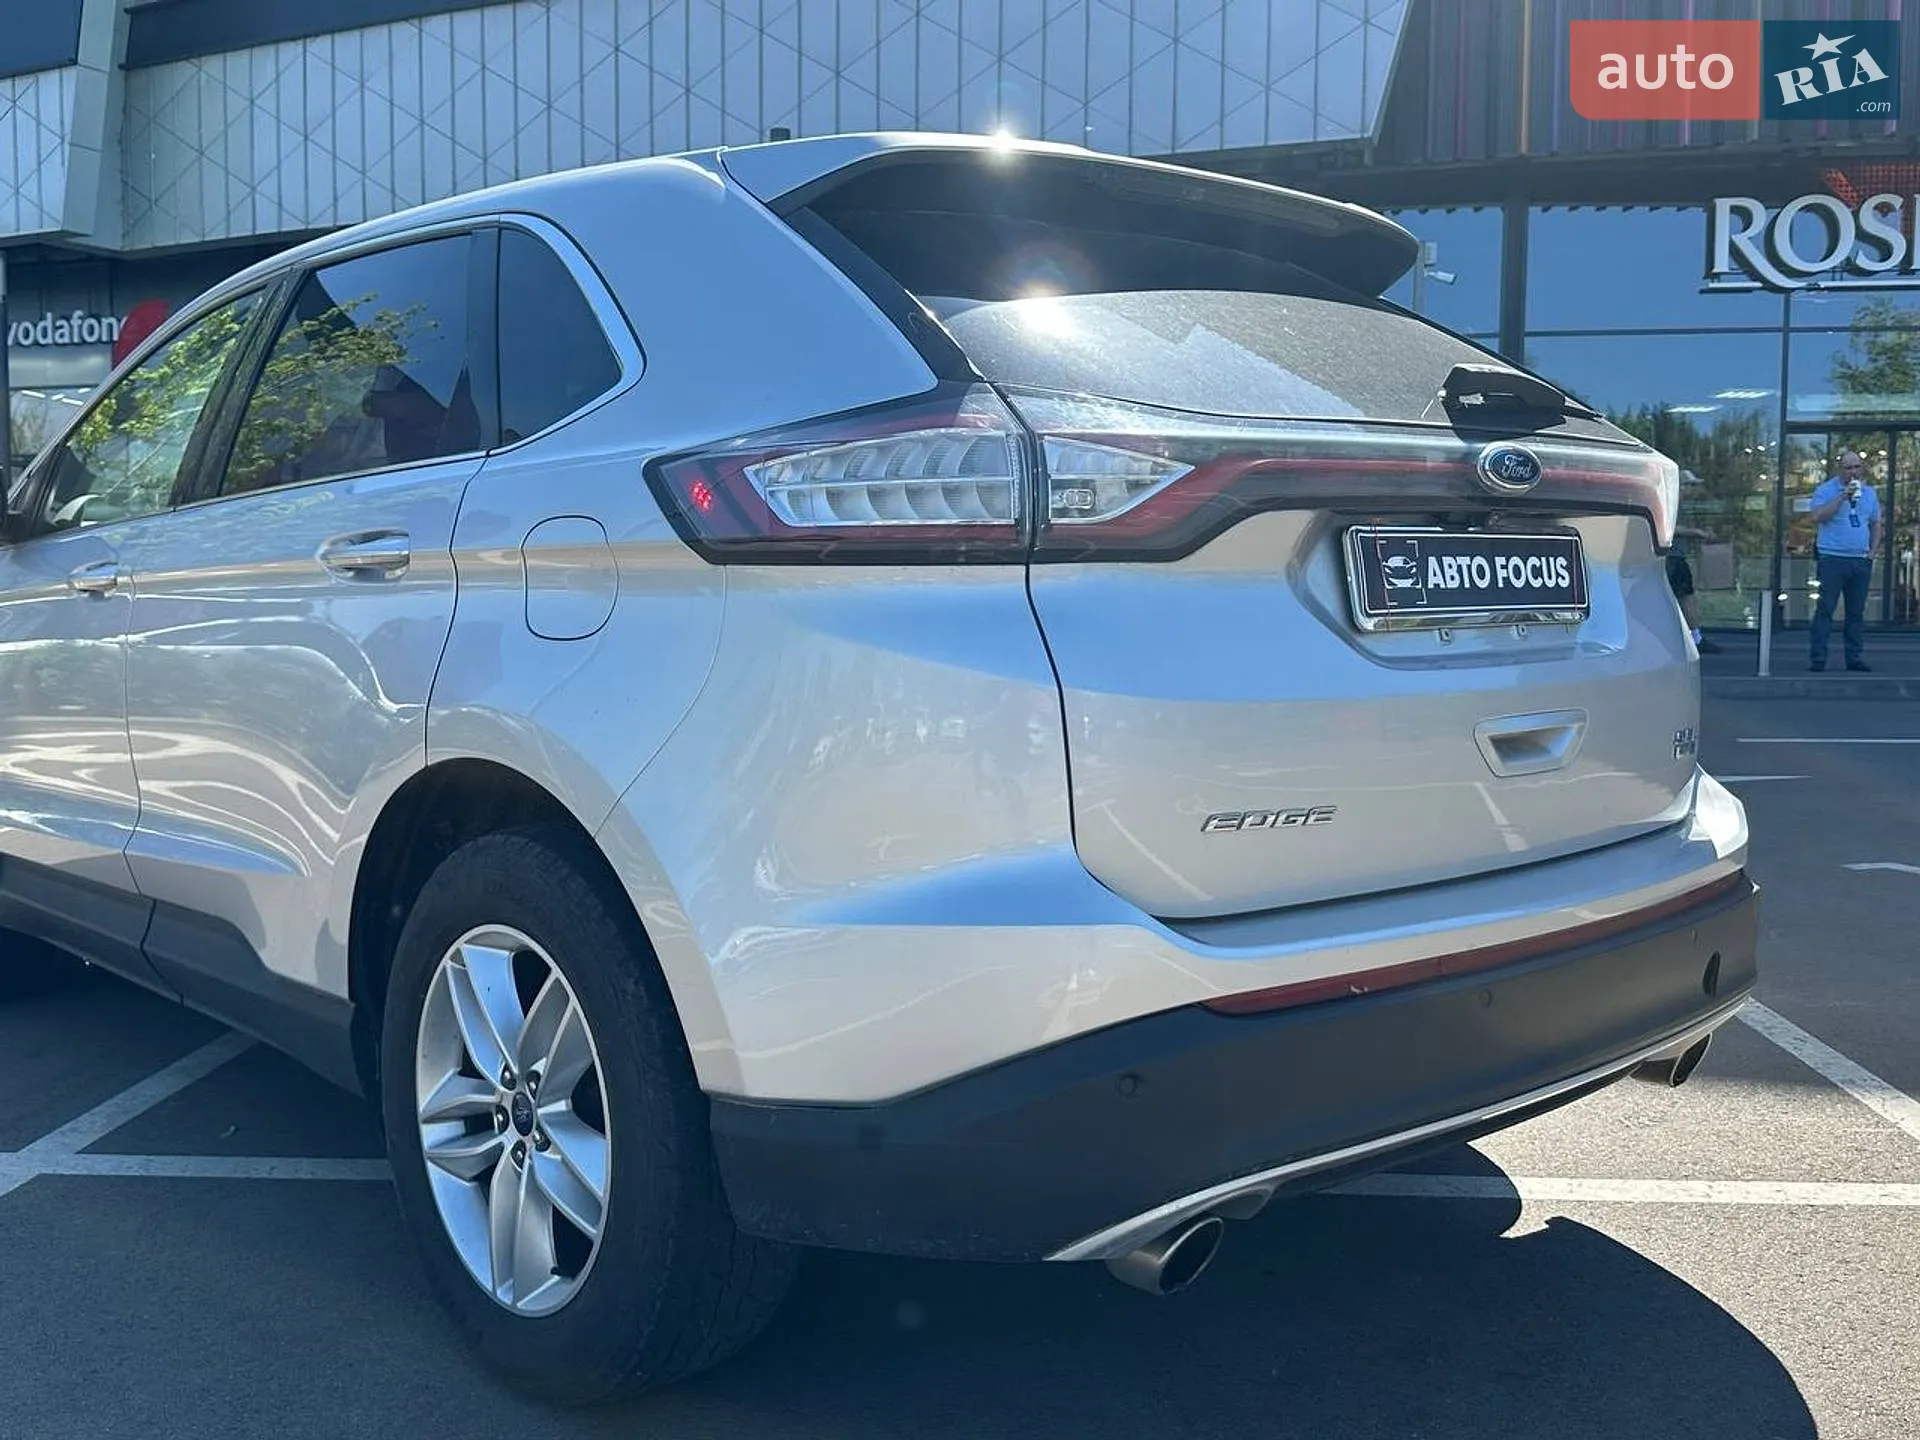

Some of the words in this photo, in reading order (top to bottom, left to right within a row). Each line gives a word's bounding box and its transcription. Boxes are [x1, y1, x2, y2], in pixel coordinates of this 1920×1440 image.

[7, 310, 128, 346] vodafon
[1501, 454, 1533, 479] Ford
[1494, 556, 1571, 589] FOCUS
[1200, 805, 1337, 832] EDGE
